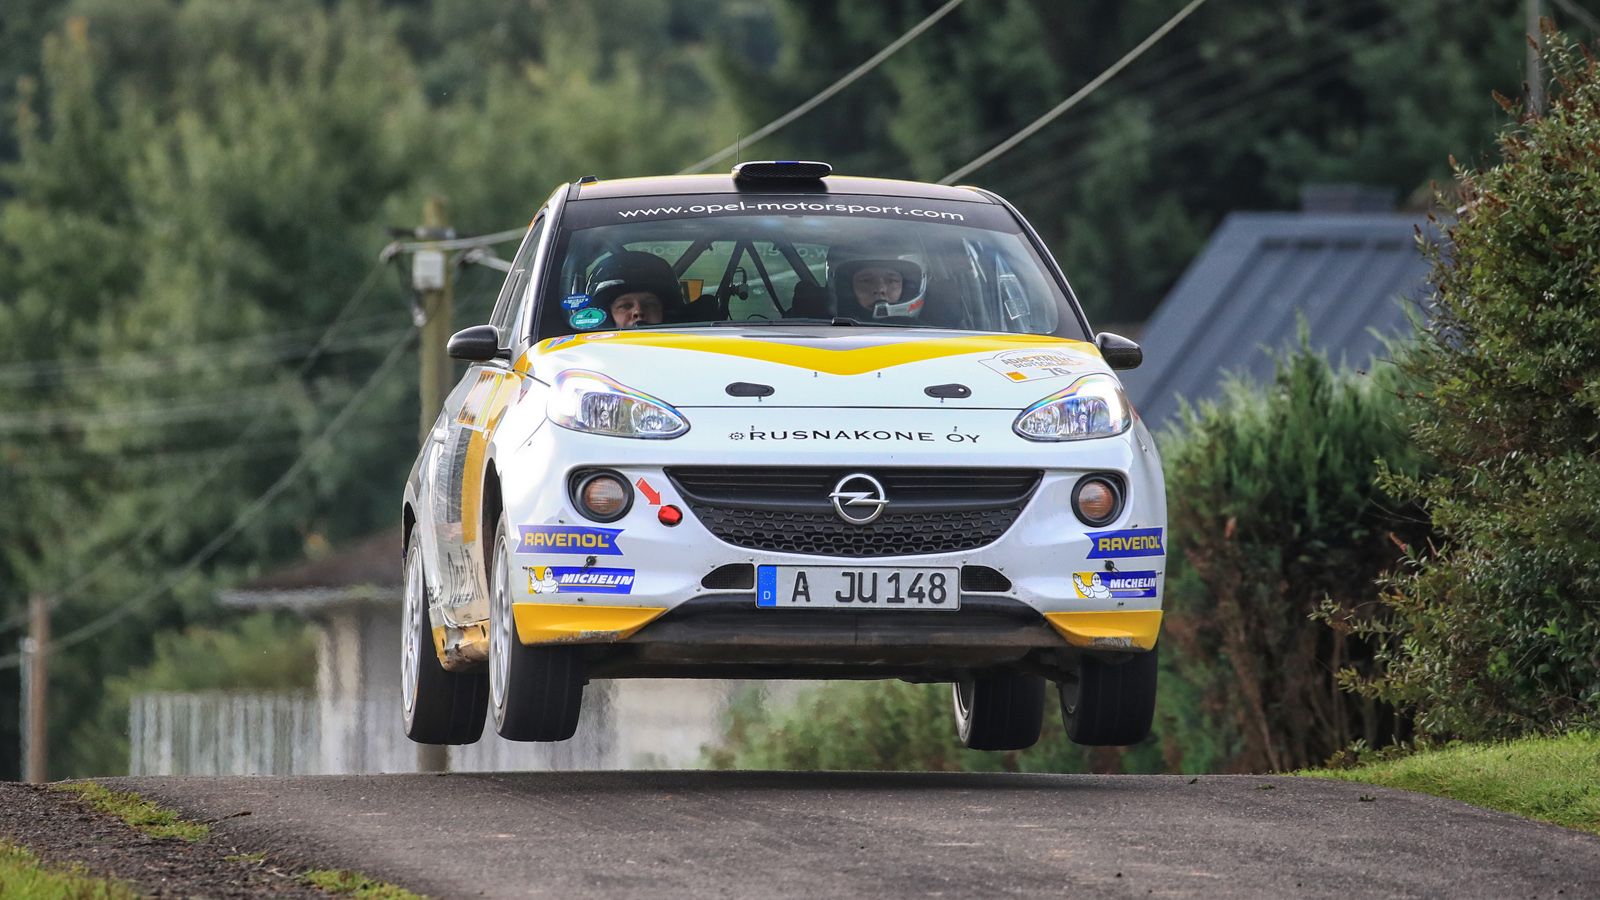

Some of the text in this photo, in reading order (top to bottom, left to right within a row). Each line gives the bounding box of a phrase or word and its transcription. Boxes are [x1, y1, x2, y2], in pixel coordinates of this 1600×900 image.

[618, 201, 965, 221] www.opel-motorsport.com
[749, 430, 981, 444] RUSNAKONE OY
[524, 532, 609, 548] RAVENOL
[1098, 535, 1161, 552] RAVENOL
[560, 573, 634, 586] MICHELIN
[763, 590, 771, 600] D
[791, 571, 811, 602] A
[1110, 577, 1156, 589] MICHELIN
